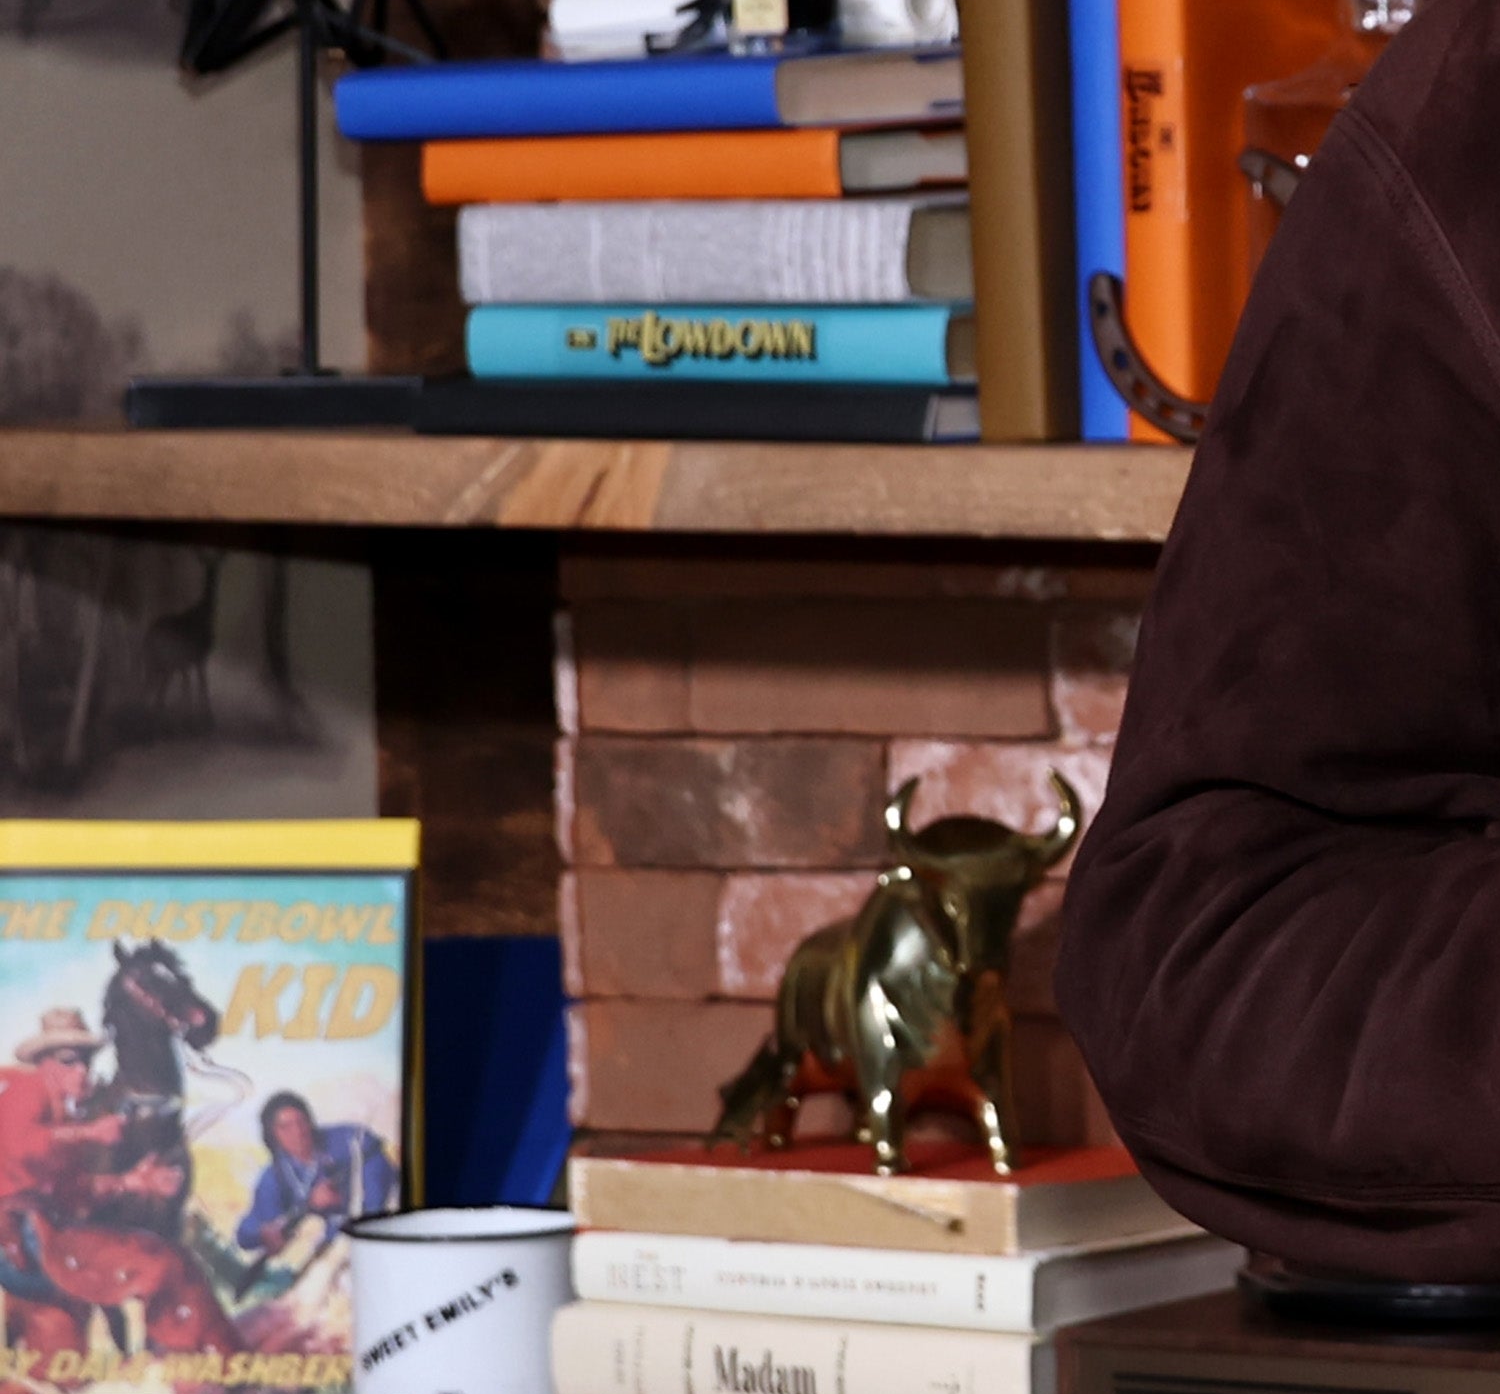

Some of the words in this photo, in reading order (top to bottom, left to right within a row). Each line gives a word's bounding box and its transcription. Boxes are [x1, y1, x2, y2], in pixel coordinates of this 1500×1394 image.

[642, 310, 816, 364] LOWDOWN
[0, 899, 77, 940] HE
[85, 900, 398, 945] DUSTBOWL
[220, 963, 401, 1041] KID
[360, 1322, 419, 1372] SWEET
[424, 1268, 520, 1332] EMILY'S
